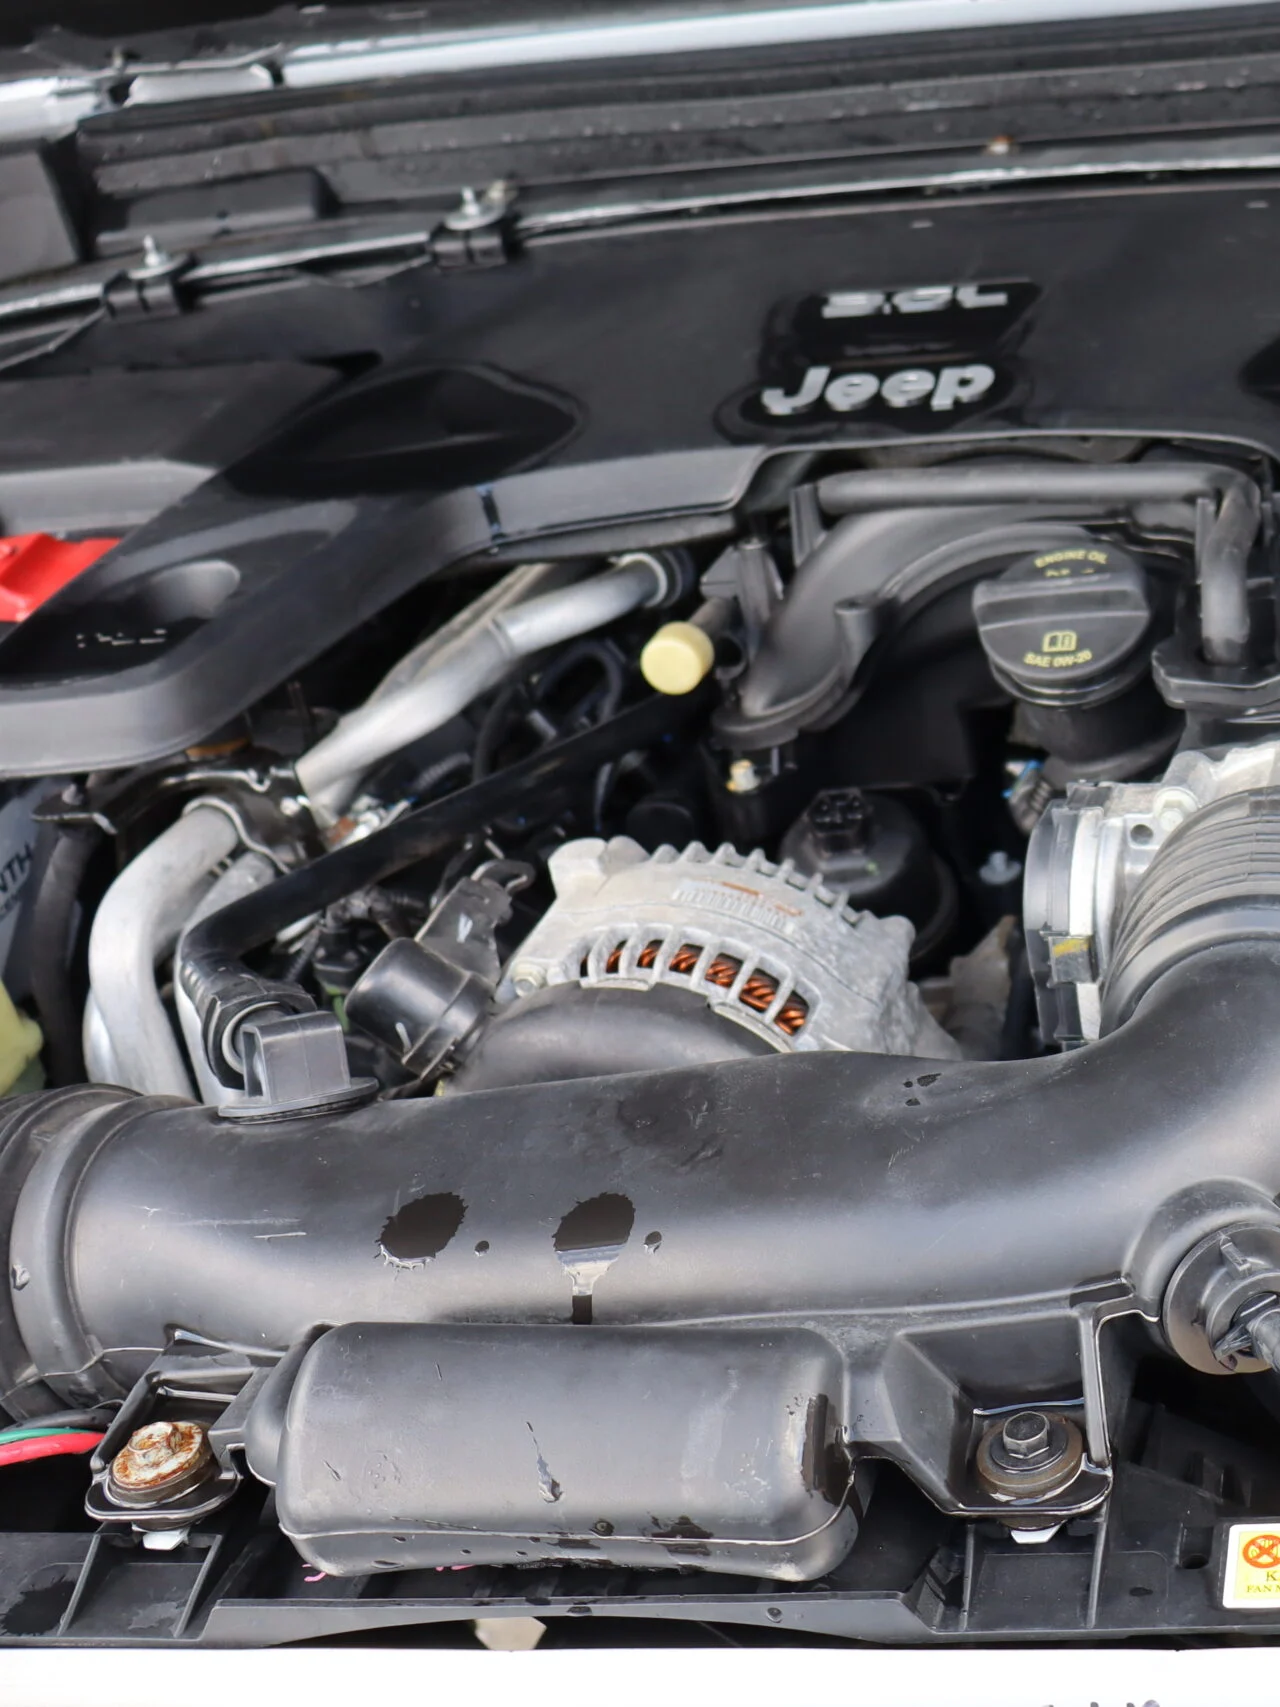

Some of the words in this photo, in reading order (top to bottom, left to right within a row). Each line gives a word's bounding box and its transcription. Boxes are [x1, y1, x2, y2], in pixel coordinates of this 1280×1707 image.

[761, 364, 995, 416] Jeep
[1035, 550, 1085, 568] ENGINE
[1088, 551, 1107, 564] OIL
[1024, 653, 1050, 668] SAE
[1246, 1584, 1272, 1594] FAN
